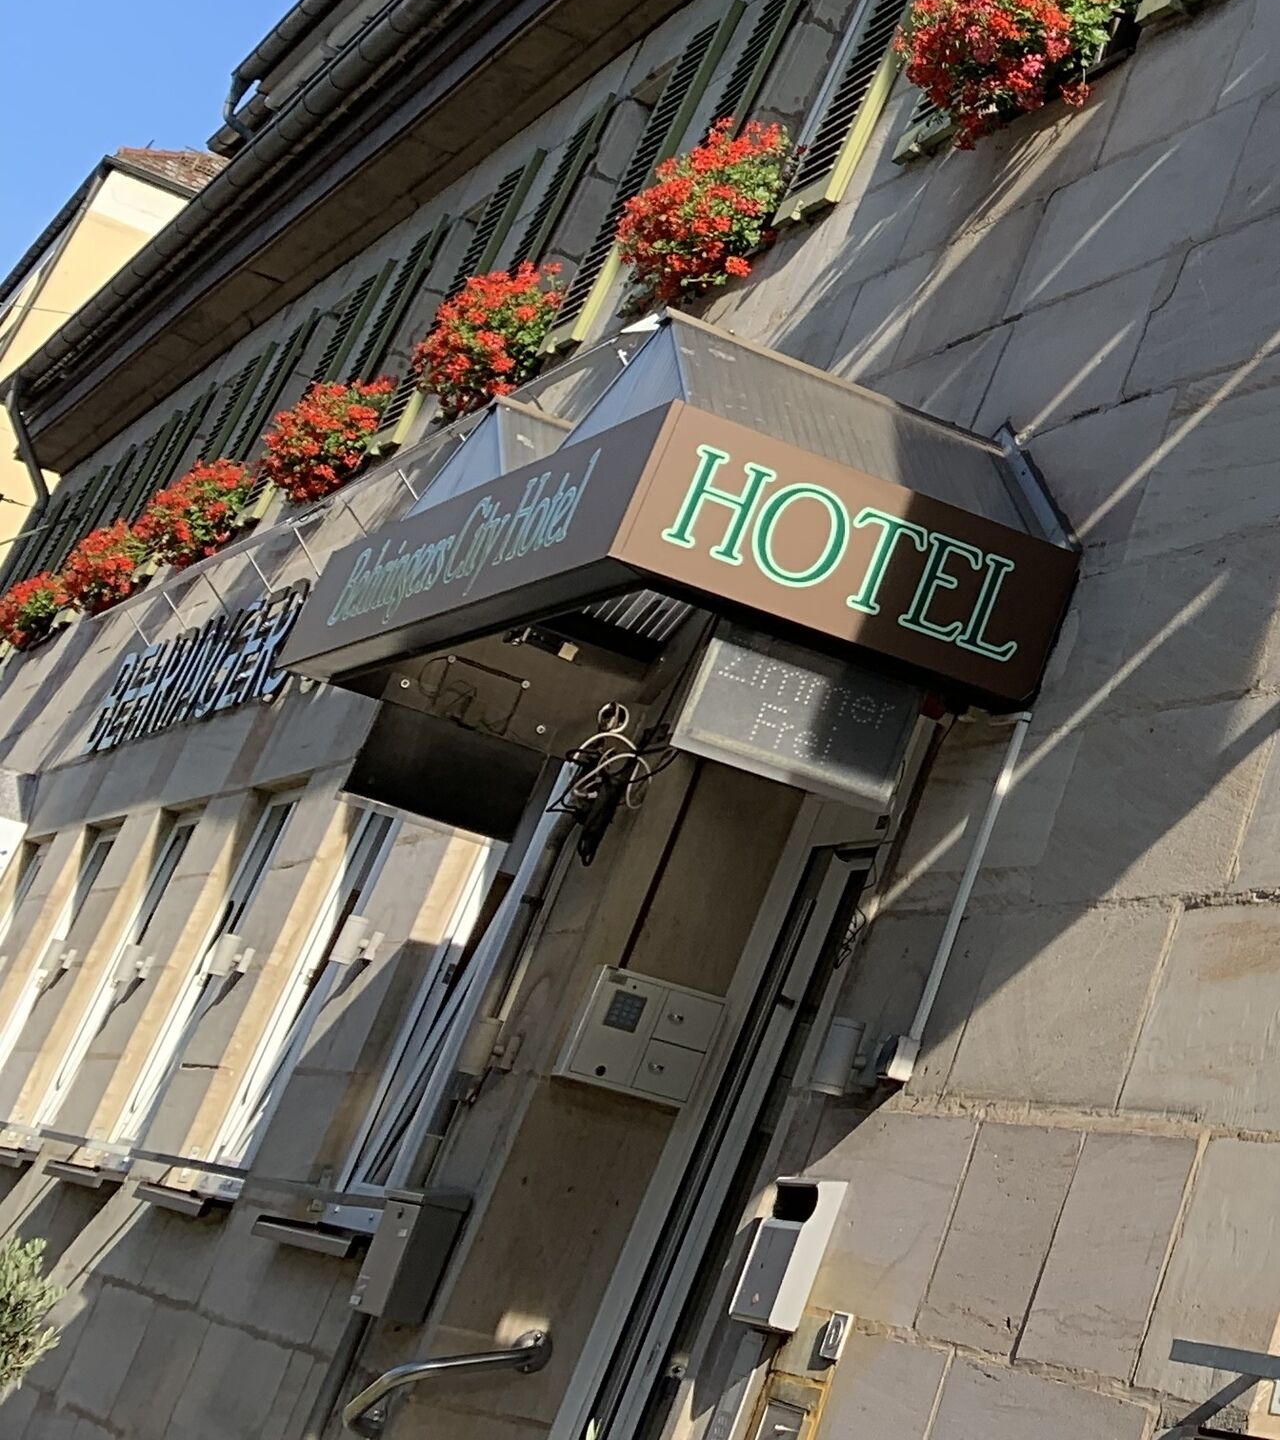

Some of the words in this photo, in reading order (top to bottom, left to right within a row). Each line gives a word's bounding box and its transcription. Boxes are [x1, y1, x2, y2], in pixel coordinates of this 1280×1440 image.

[326, 534, 457, 626] Behringers
[443, 495, 511, 596] City
[492, 448, 602, 566] Hotel
[661, 444, 1018, 662] HOTEL
[717, 637, 897, 730] Zimmer
[748, 700, 838, 766] Frei
